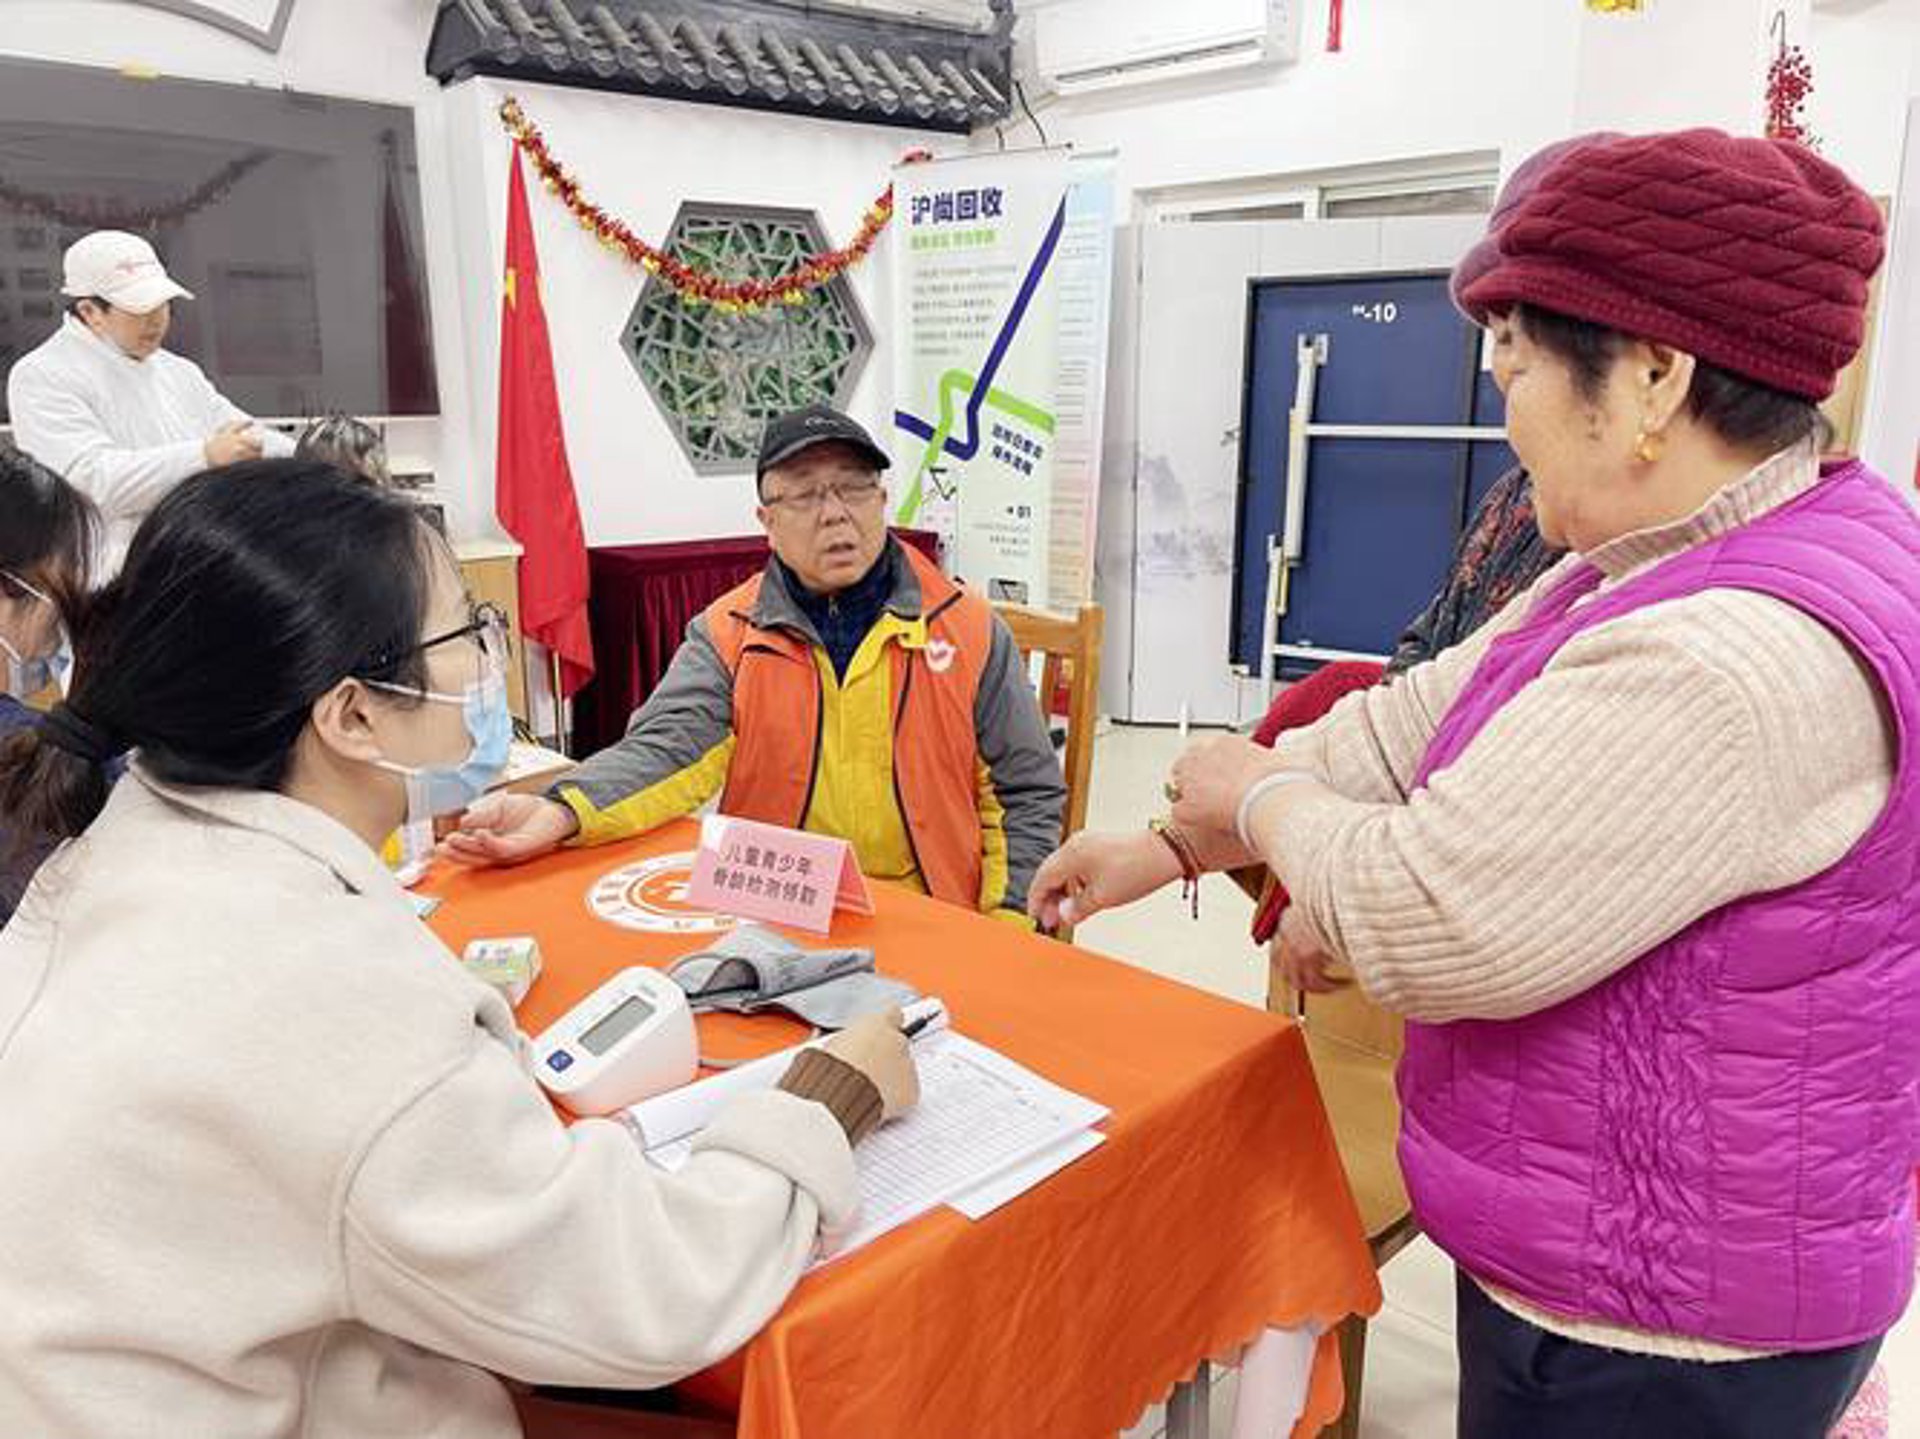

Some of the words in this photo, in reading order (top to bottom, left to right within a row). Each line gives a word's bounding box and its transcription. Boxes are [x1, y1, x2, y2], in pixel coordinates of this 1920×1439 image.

[911, 187, 1003, 225] 沪尚回收
[724, 844, 812, 875] 儿童青少年
